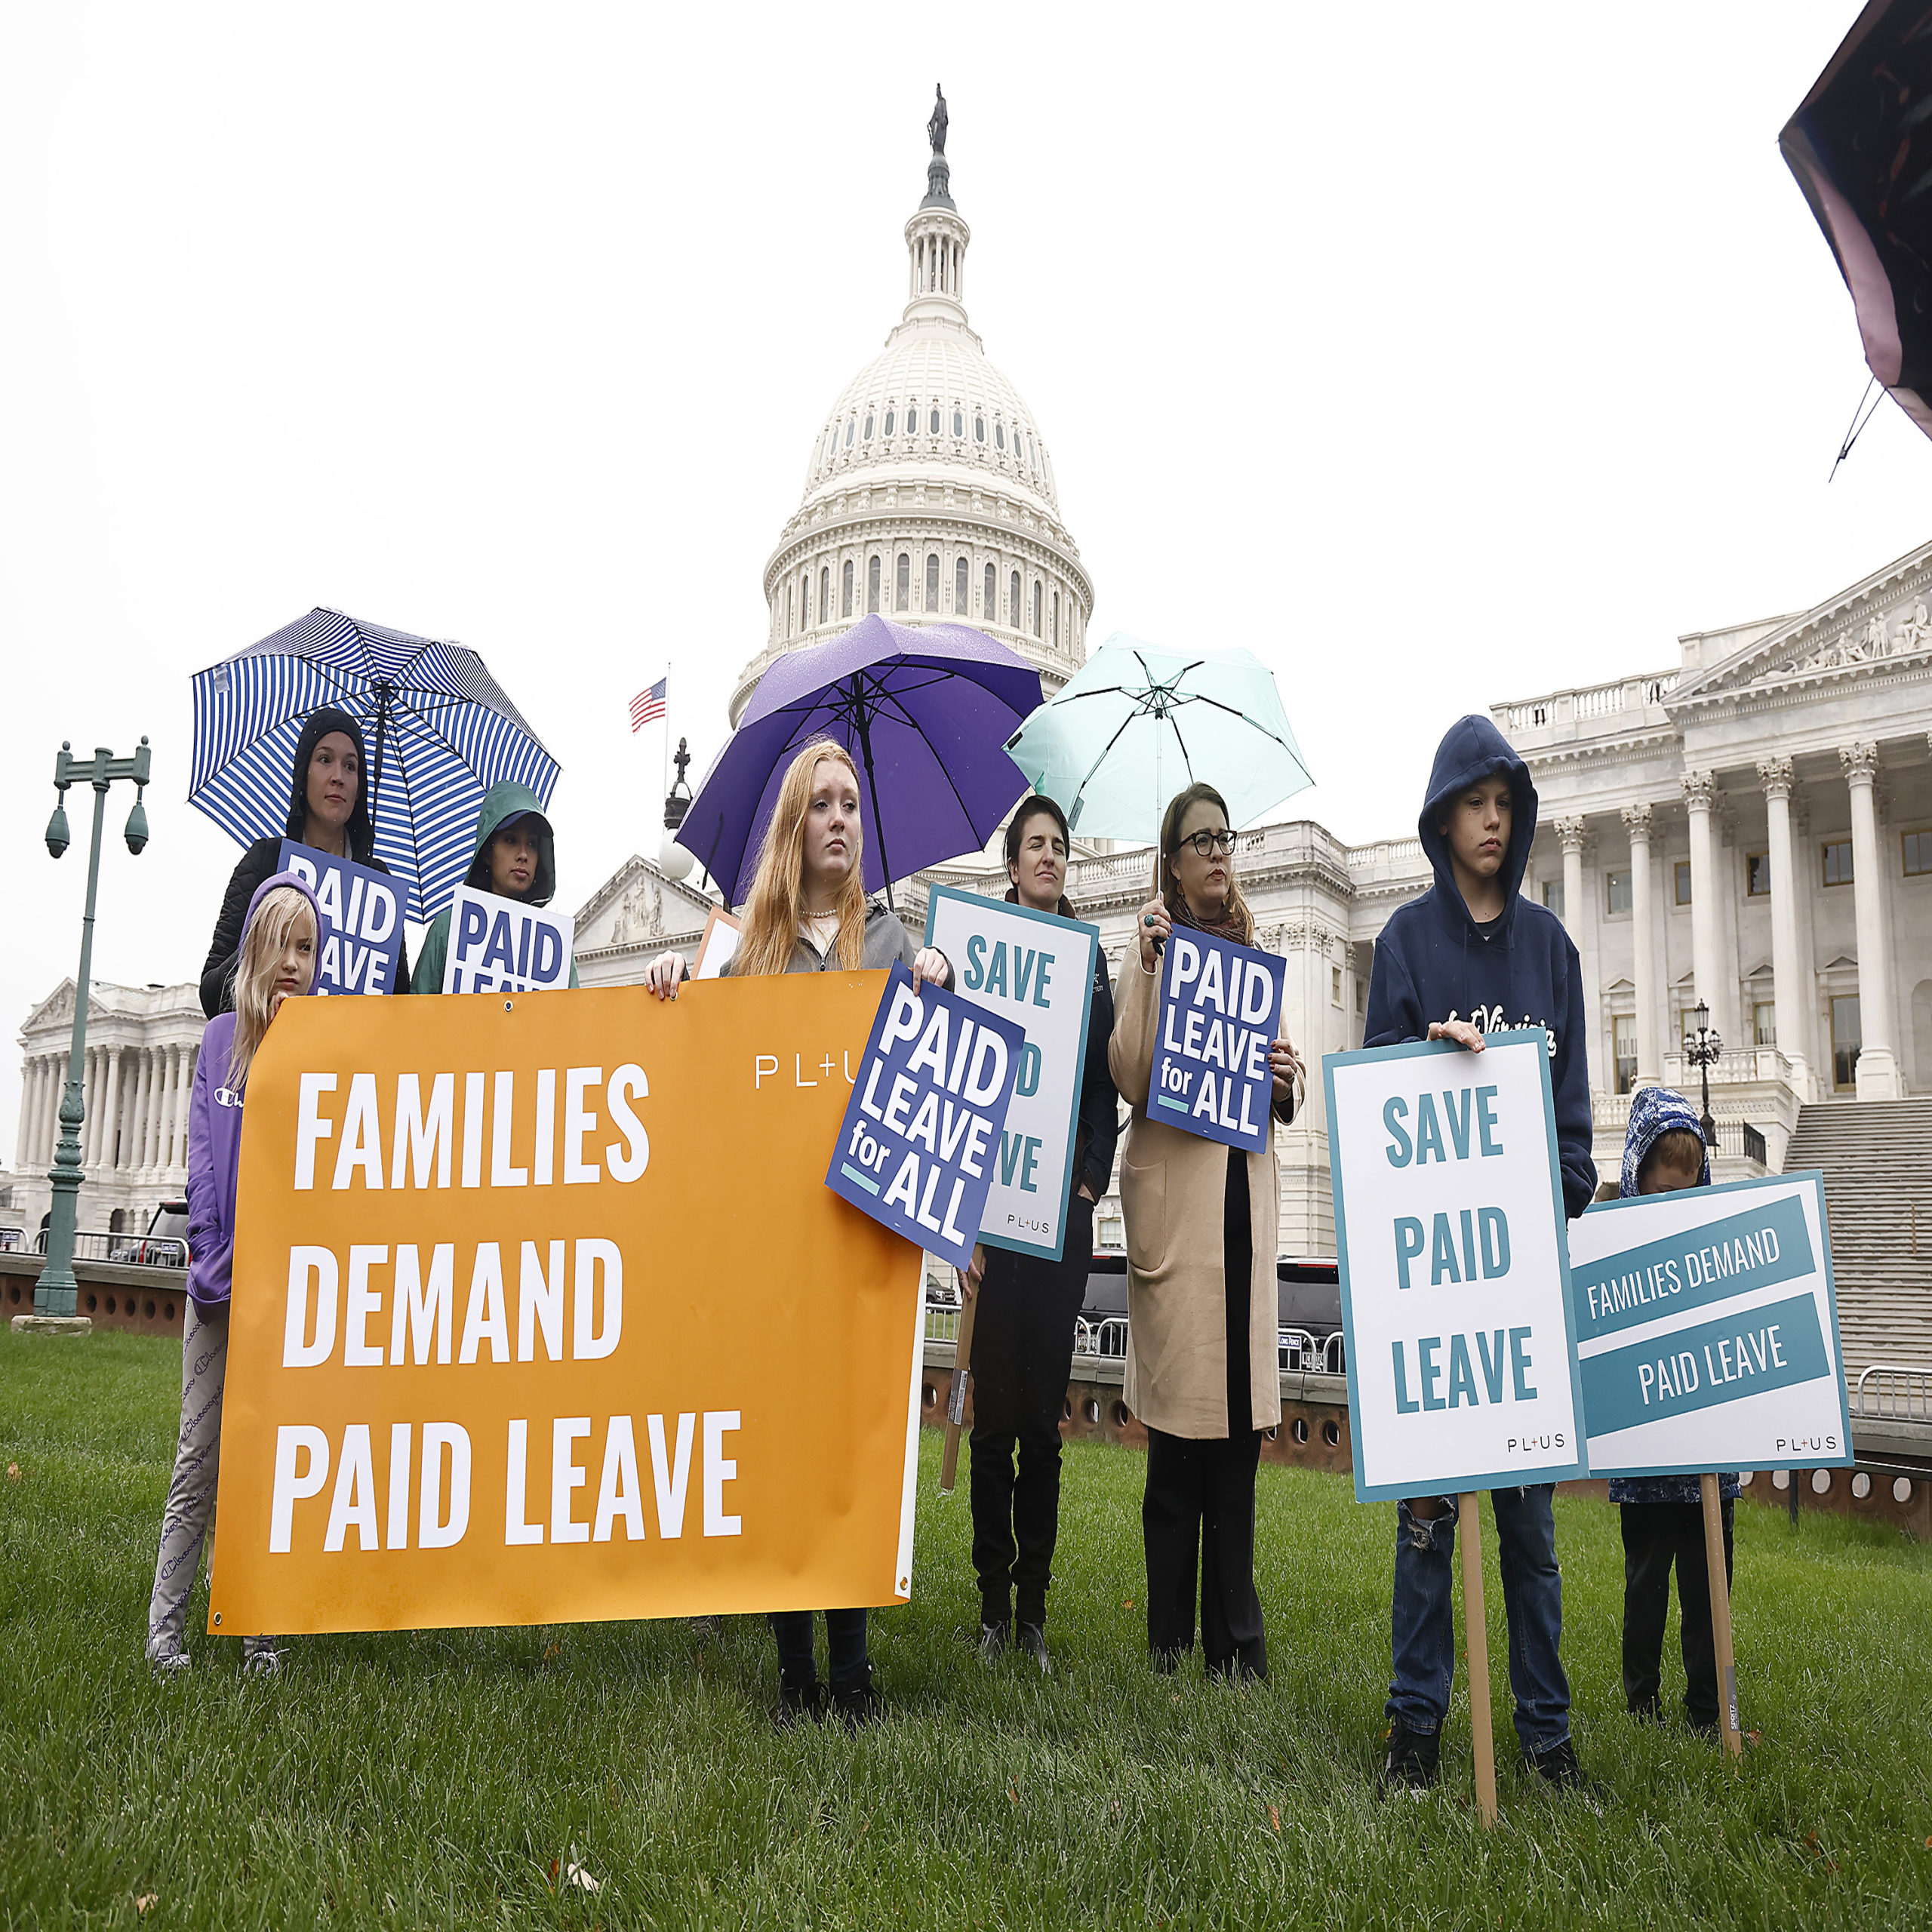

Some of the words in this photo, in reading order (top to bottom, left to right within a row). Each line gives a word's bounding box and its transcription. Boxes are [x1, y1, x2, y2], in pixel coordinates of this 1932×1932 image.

[319, 934, 389, 995] AVE
[456, 900, 563, 983] PAID
[964, 934, 1056, 1009] SAVE
[1169, 937, 1274, 1026] PAID
[878, 980, 1008, 1108] PAID
[1163, 1003, 1269, 1081] LEAVE
[294, 1063, 650, 1190] FAMILIES
[860, 1056, 994, 1180] LEAVE
[1161, 1057, 1192, 1095] for
[1192, 1069, 1259, 1137] ALL
[1383, 1085, 1504, 1168] SAVE
[848, 1119, 891, 1174] for
[882, 1151, 966, 1248] ALL
[1394, 1207, 1511, 1290] PAID
[1587, 1260, 1682, 1320] FAMILIES
[1684, 1227, 1780, 1288] DEMAND
[282, 1238, 623, 1367] DEMAND
[1392, 1326, 1538, 1414] LEAVE
[1638, 1351, 1700, 1405] PAID
[1704, 1324, 1788, 1386] LEAVE
[269, 1422, 472, 1553] PAID
[505, 1410, 742, 1546] LEAVE
